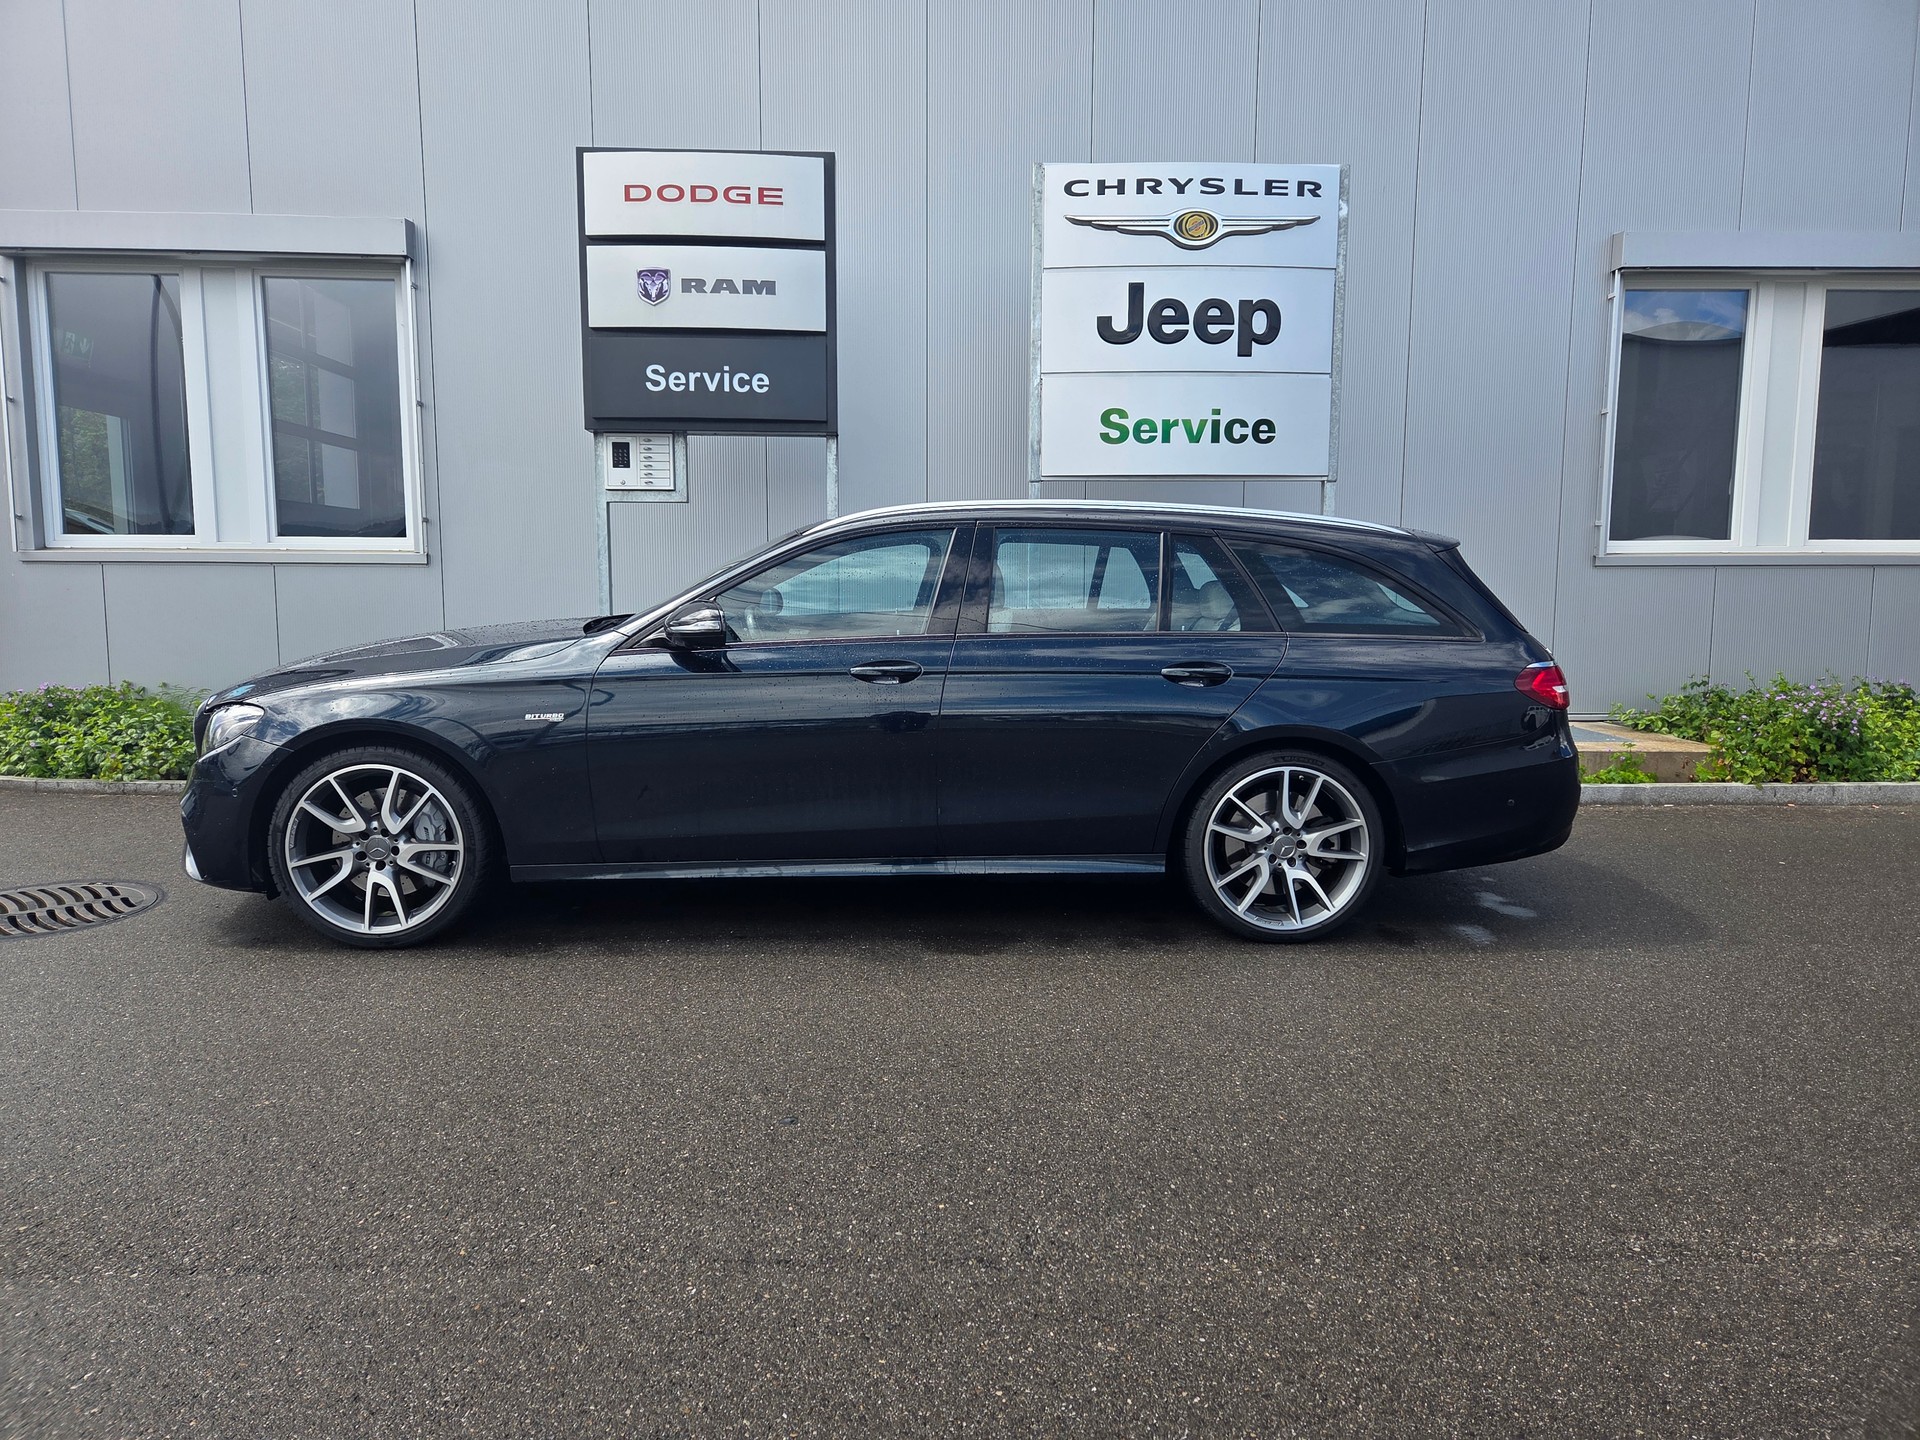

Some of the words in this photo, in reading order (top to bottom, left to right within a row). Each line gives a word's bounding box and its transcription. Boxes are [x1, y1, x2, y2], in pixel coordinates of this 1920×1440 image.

[623, 184, 784, 206] DODGE
[1063, 177, 1322, 198] CHRYSLER
[680, 278, 777, 296] RAM
[1096, 282, 1282, 357] Jeep
[645, 364, 770, 393] Service
[1099, 407, 1277, 445] Service
[525, 712, 565, 720] BITURBO
